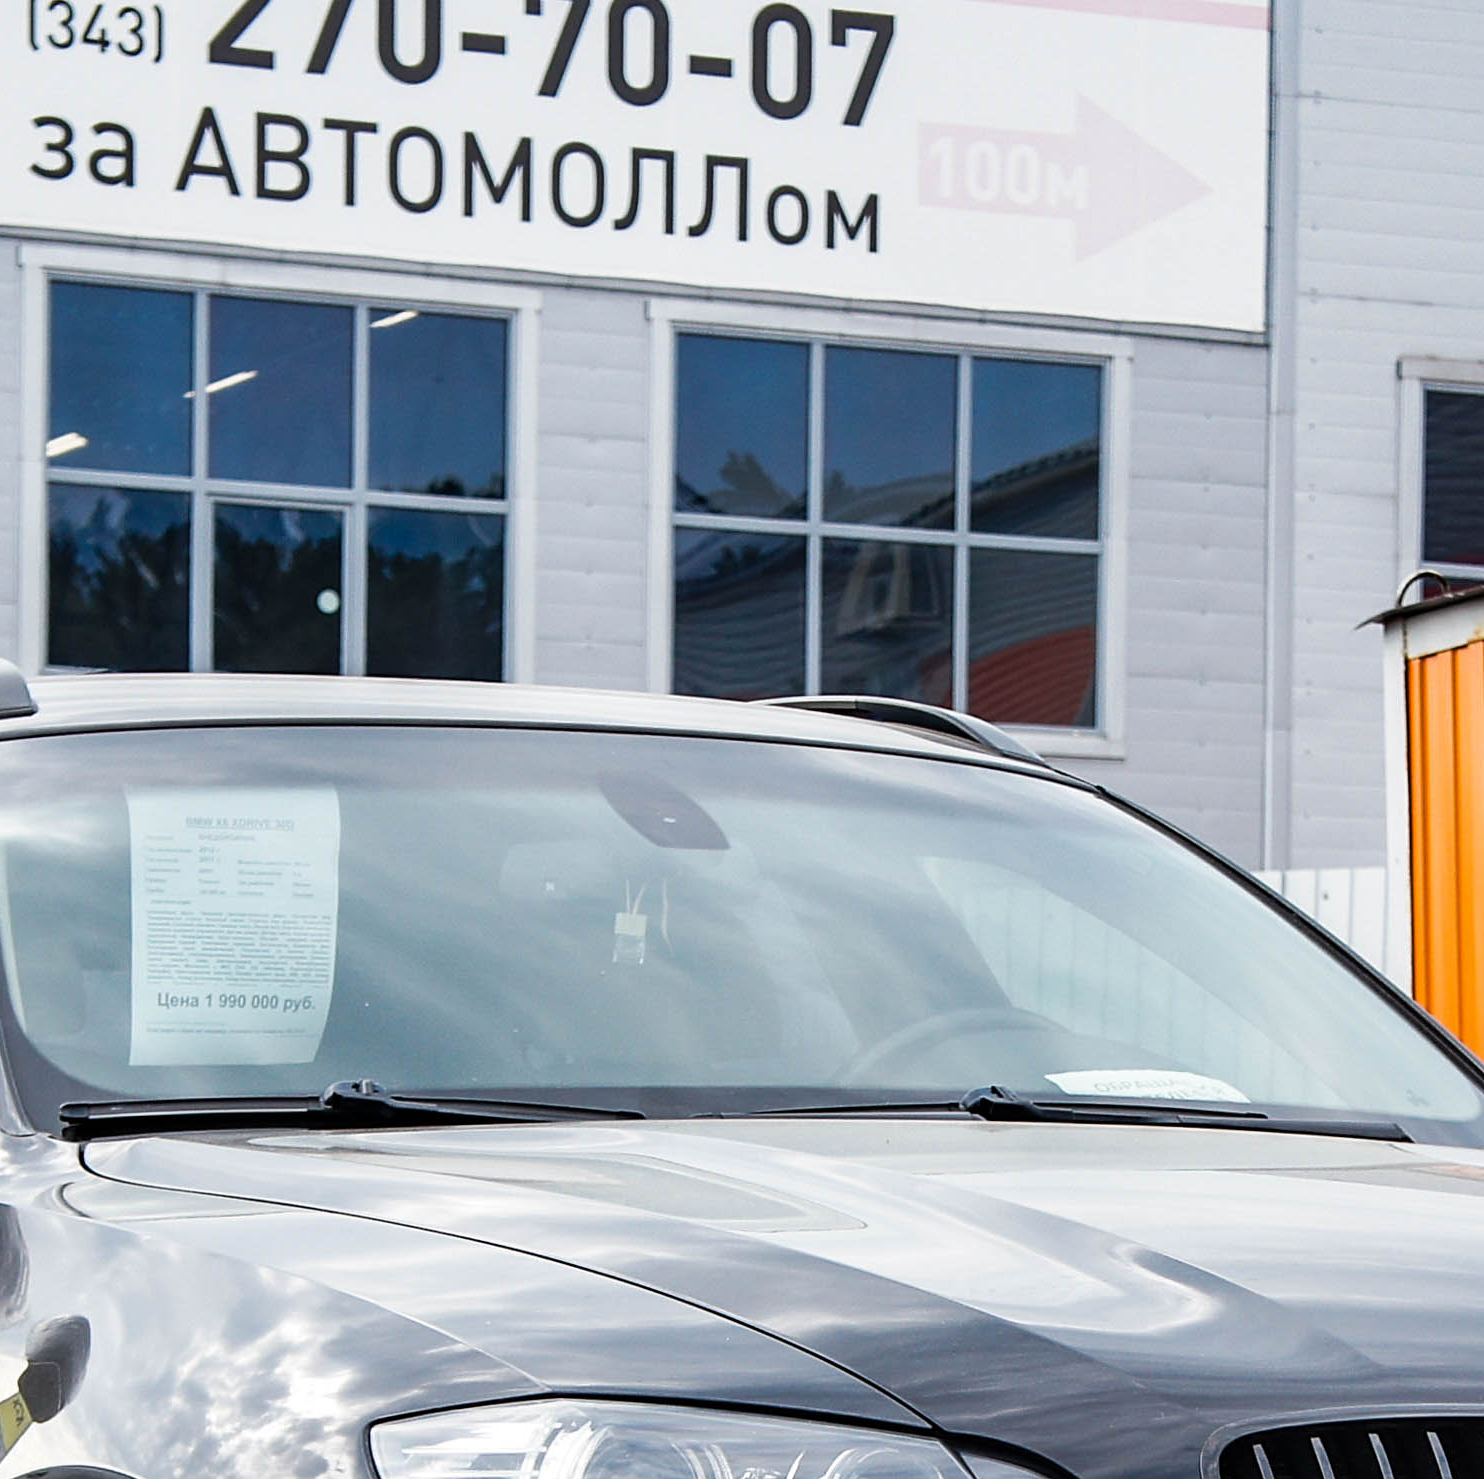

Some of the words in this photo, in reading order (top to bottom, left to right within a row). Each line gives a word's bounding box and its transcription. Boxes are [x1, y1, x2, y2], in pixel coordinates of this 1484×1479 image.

[28, 0, 164, 62] (343)
[209, 0, 896, 127] 270-70-07
[30, 116, 135, 187] за
[175, 106, 879, 253] АВТОМОЛЛом
[157, 992, 199, 1009] Цена
[206, 993, 213, 1008] 1
[219, 993, 247, 1009] 990
[251, 994, 279, 1010] 000
[283, 994, 316, 1013] руб.
